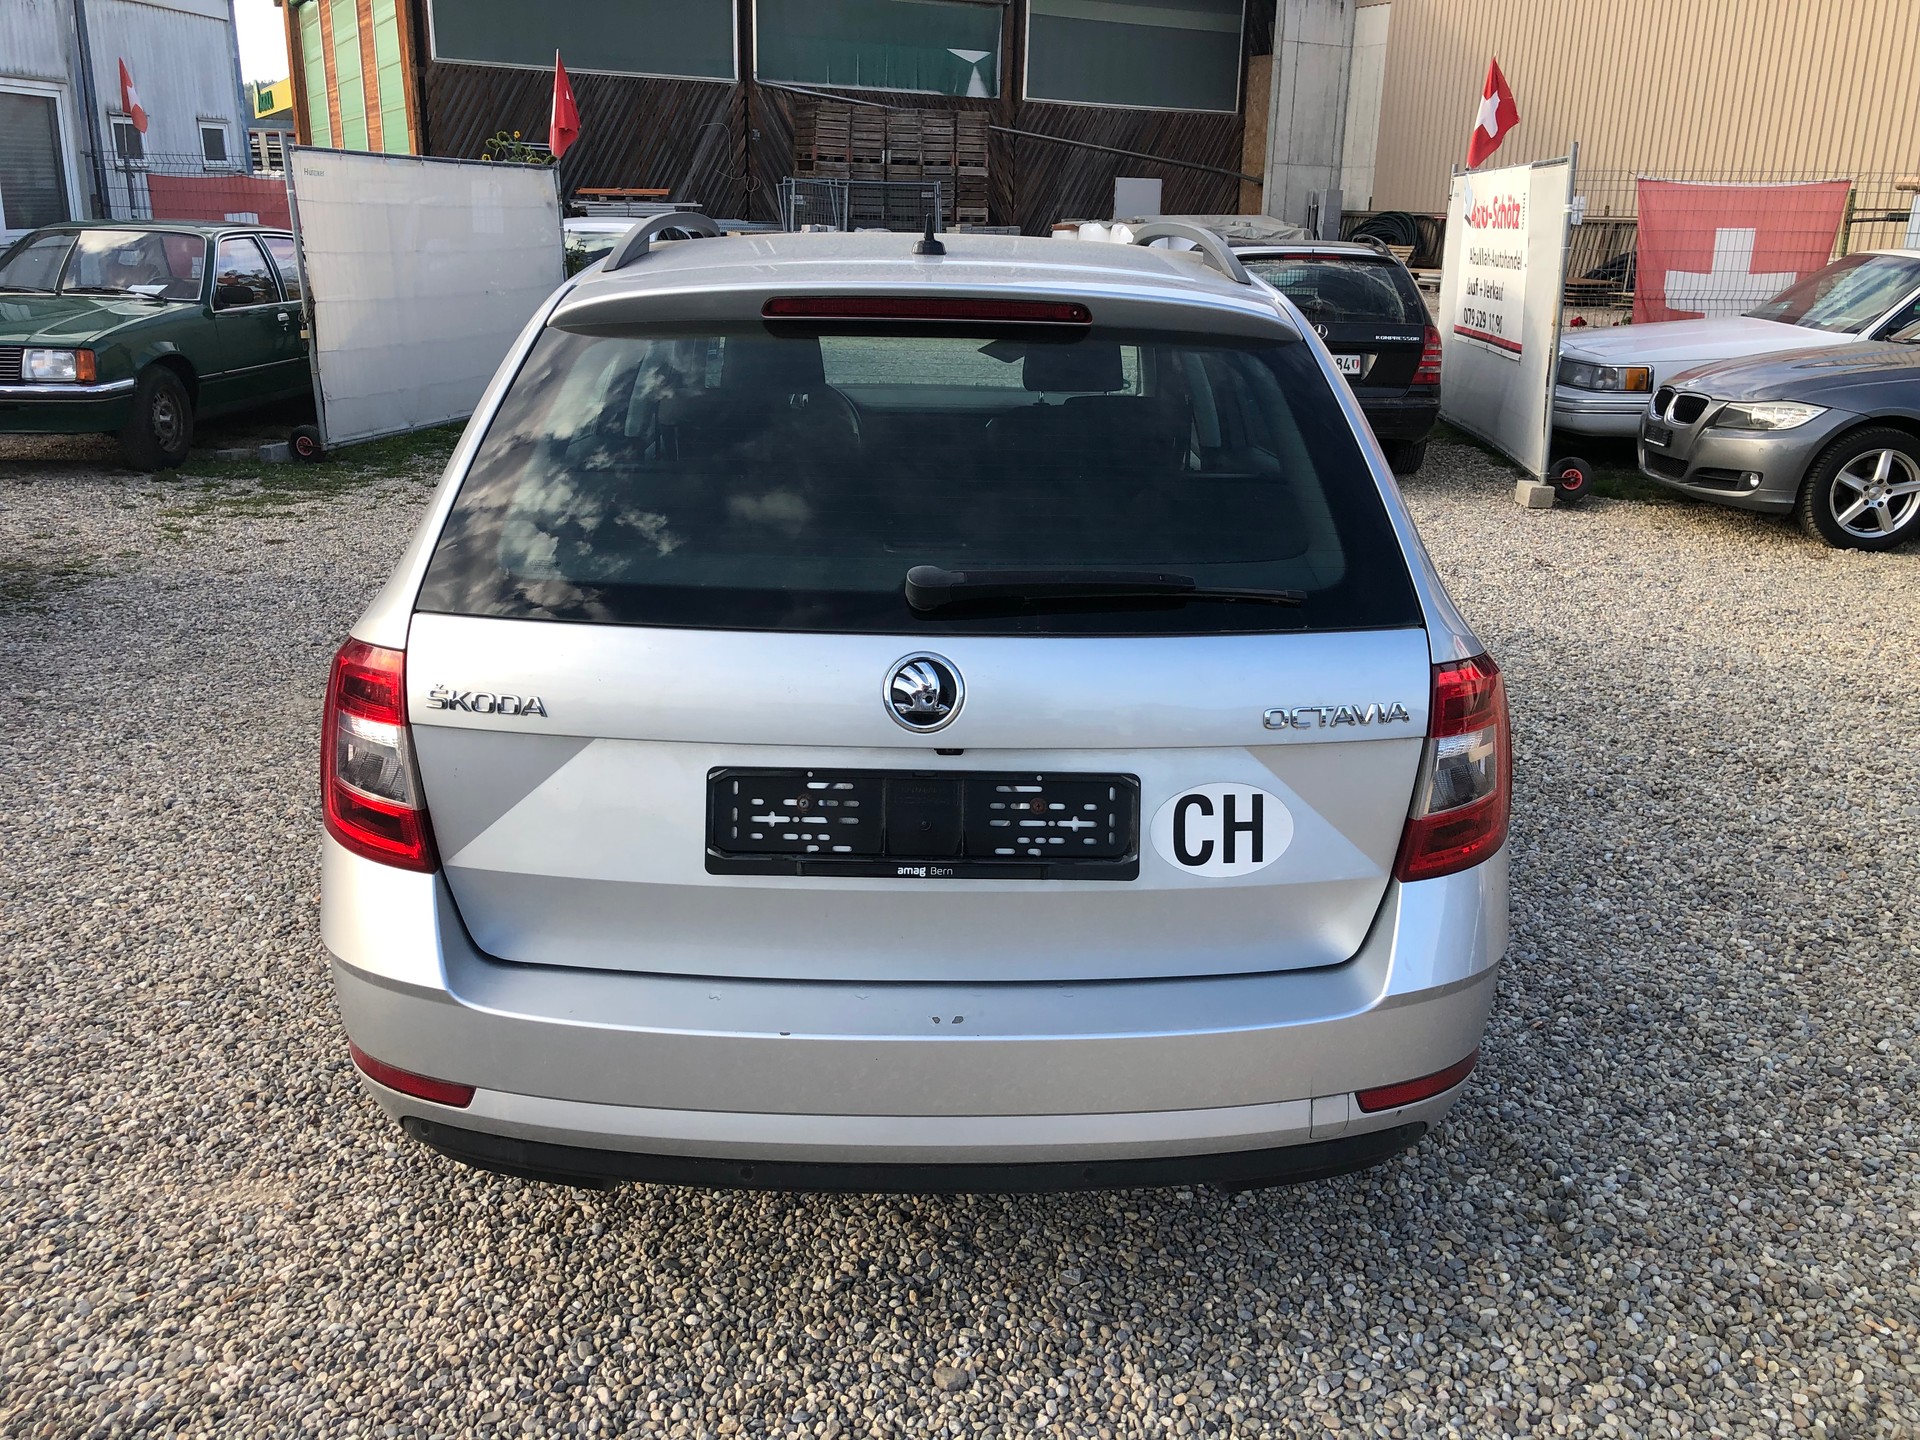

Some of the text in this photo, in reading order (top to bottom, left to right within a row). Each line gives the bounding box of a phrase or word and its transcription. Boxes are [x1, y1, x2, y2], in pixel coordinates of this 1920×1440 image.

[1463, 307, 1475, 326] 079
[426, 683, 548, 718] ŠKODA
[1263, 701, 1411, 730] OCTAVIA
[1173, 793, 1264, 867] CH
[897, 866, 953, 877] amag Bern
